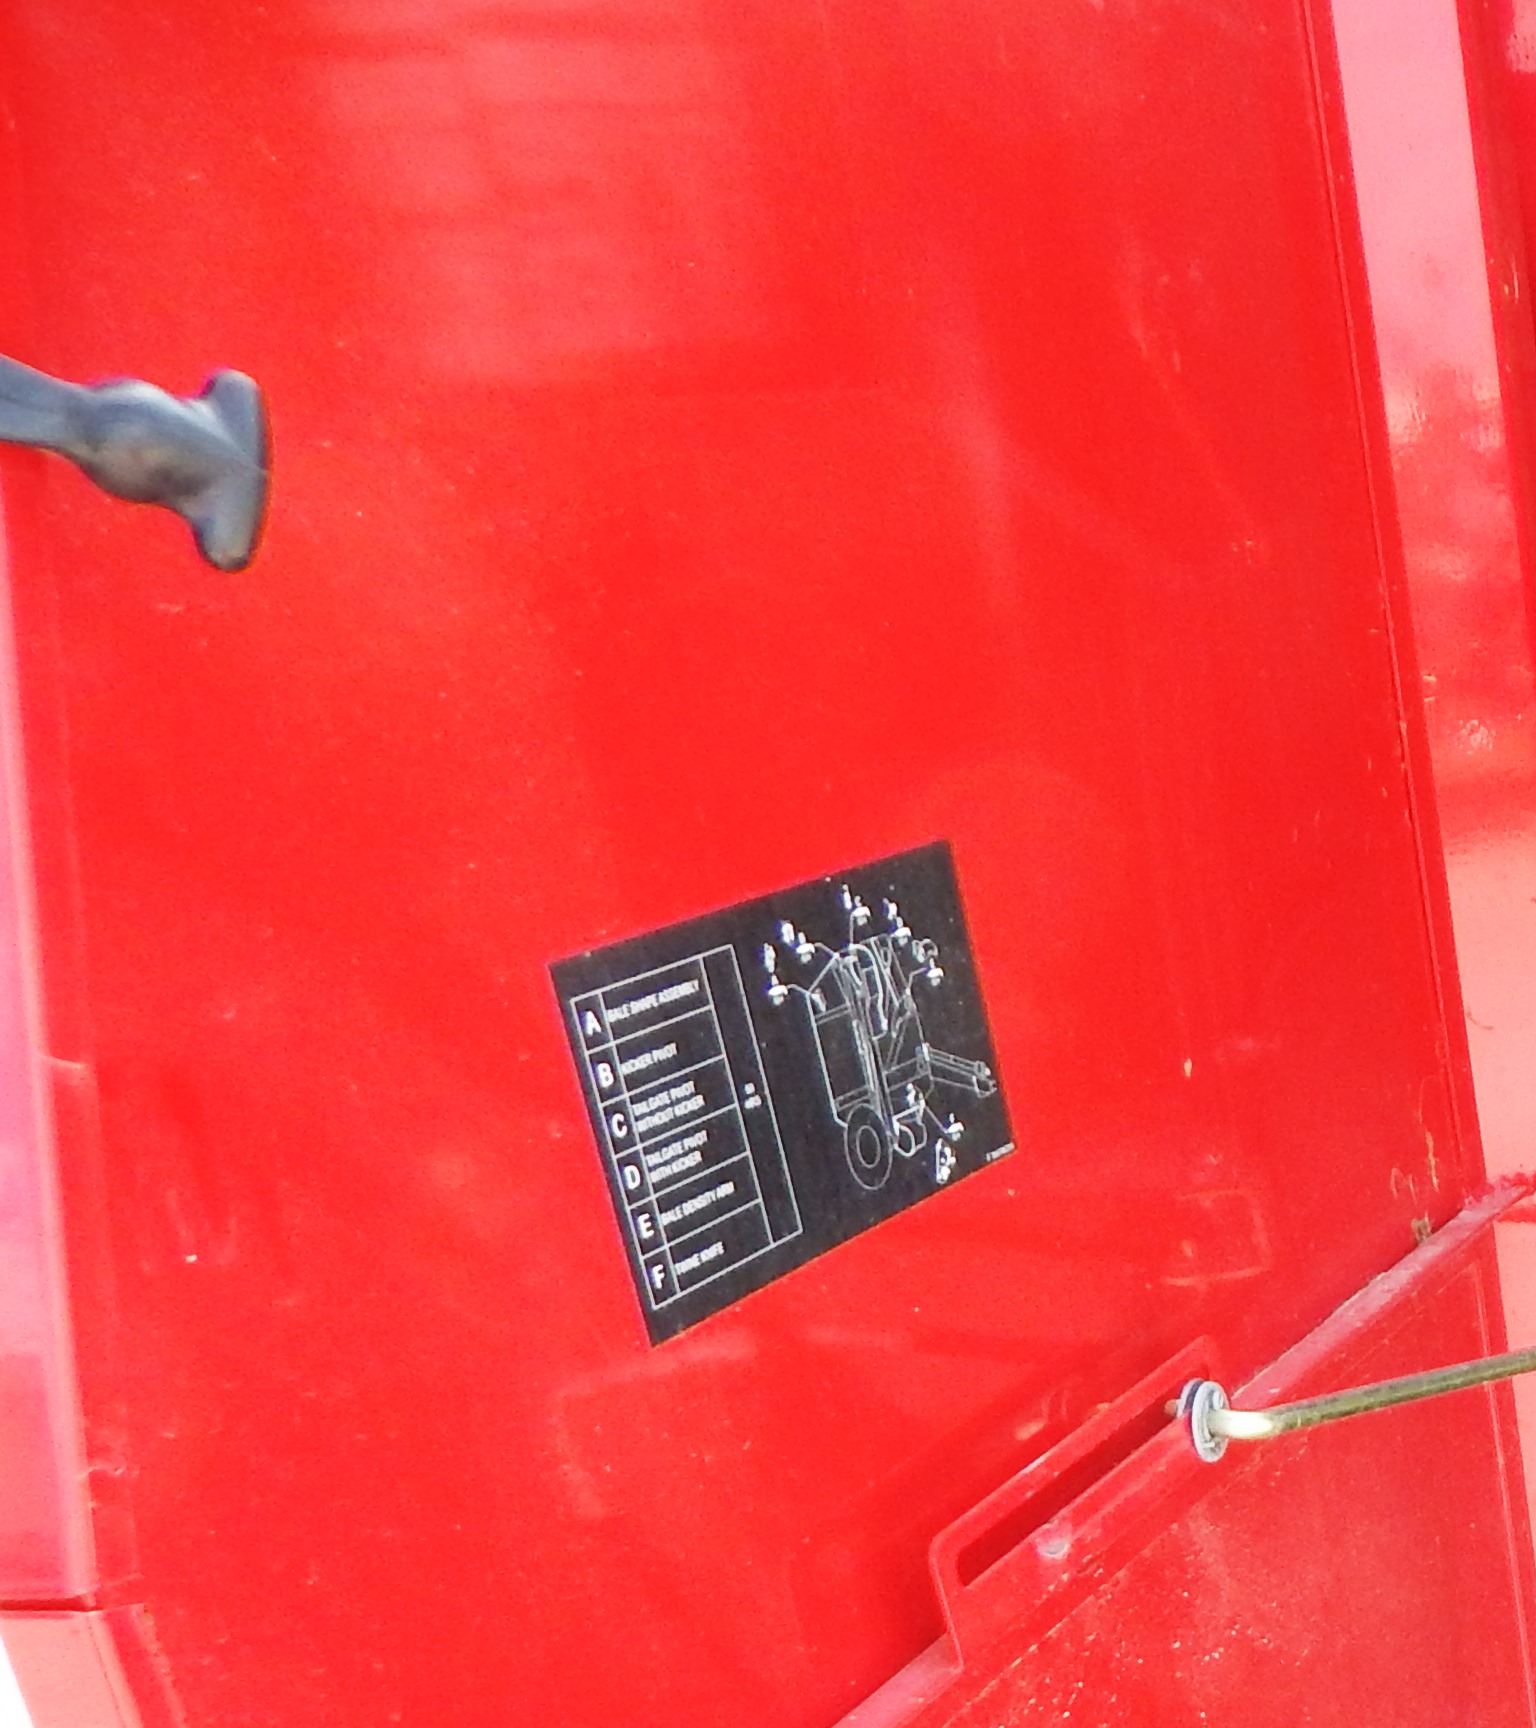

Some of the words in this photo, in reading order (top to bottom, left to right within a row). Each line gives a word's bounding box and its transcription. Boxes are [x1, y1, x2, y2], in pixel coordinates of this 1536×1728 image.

[584, 1010, 601, 1037] A
[597, 1063, 614, 1088] B
[611, 1113, 628, 1138] C
[623, 1165, 641, 1190] D
[637, 1213, 654, 1239] E
[651, 1264, 665, 1289] F
